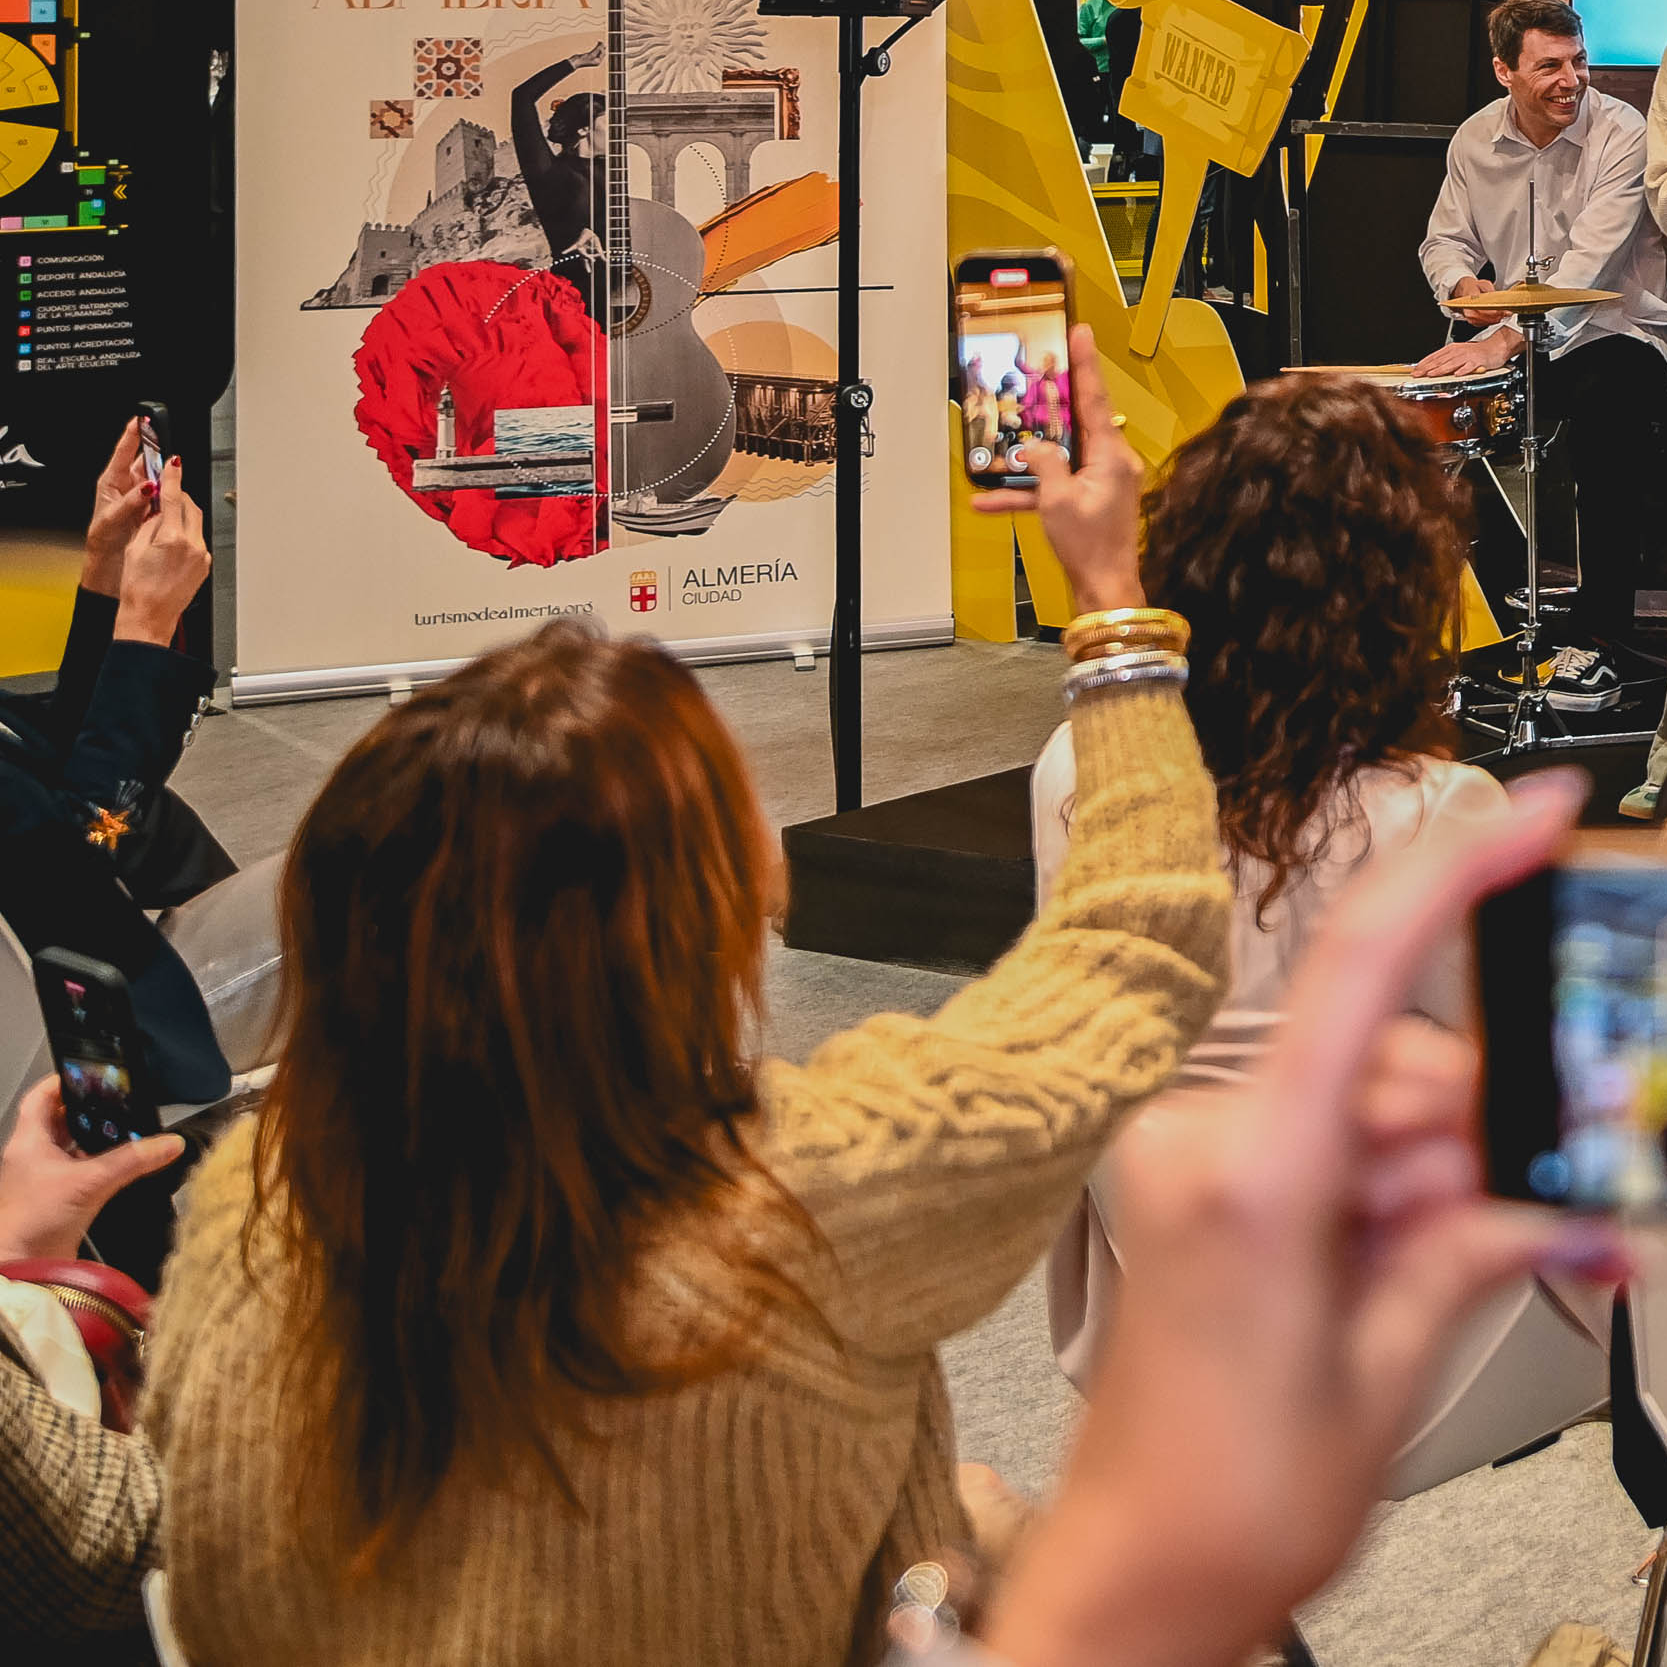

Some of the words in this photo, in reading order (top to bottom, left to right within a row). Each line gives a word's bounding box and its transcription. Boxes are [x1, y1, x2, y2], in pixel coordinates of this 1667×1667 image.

[1161, 32, 1236, 106] WANTED
[682, 558, 798, 589] ALMERÍA
[682, 589, 742, 606] CIUDAD
